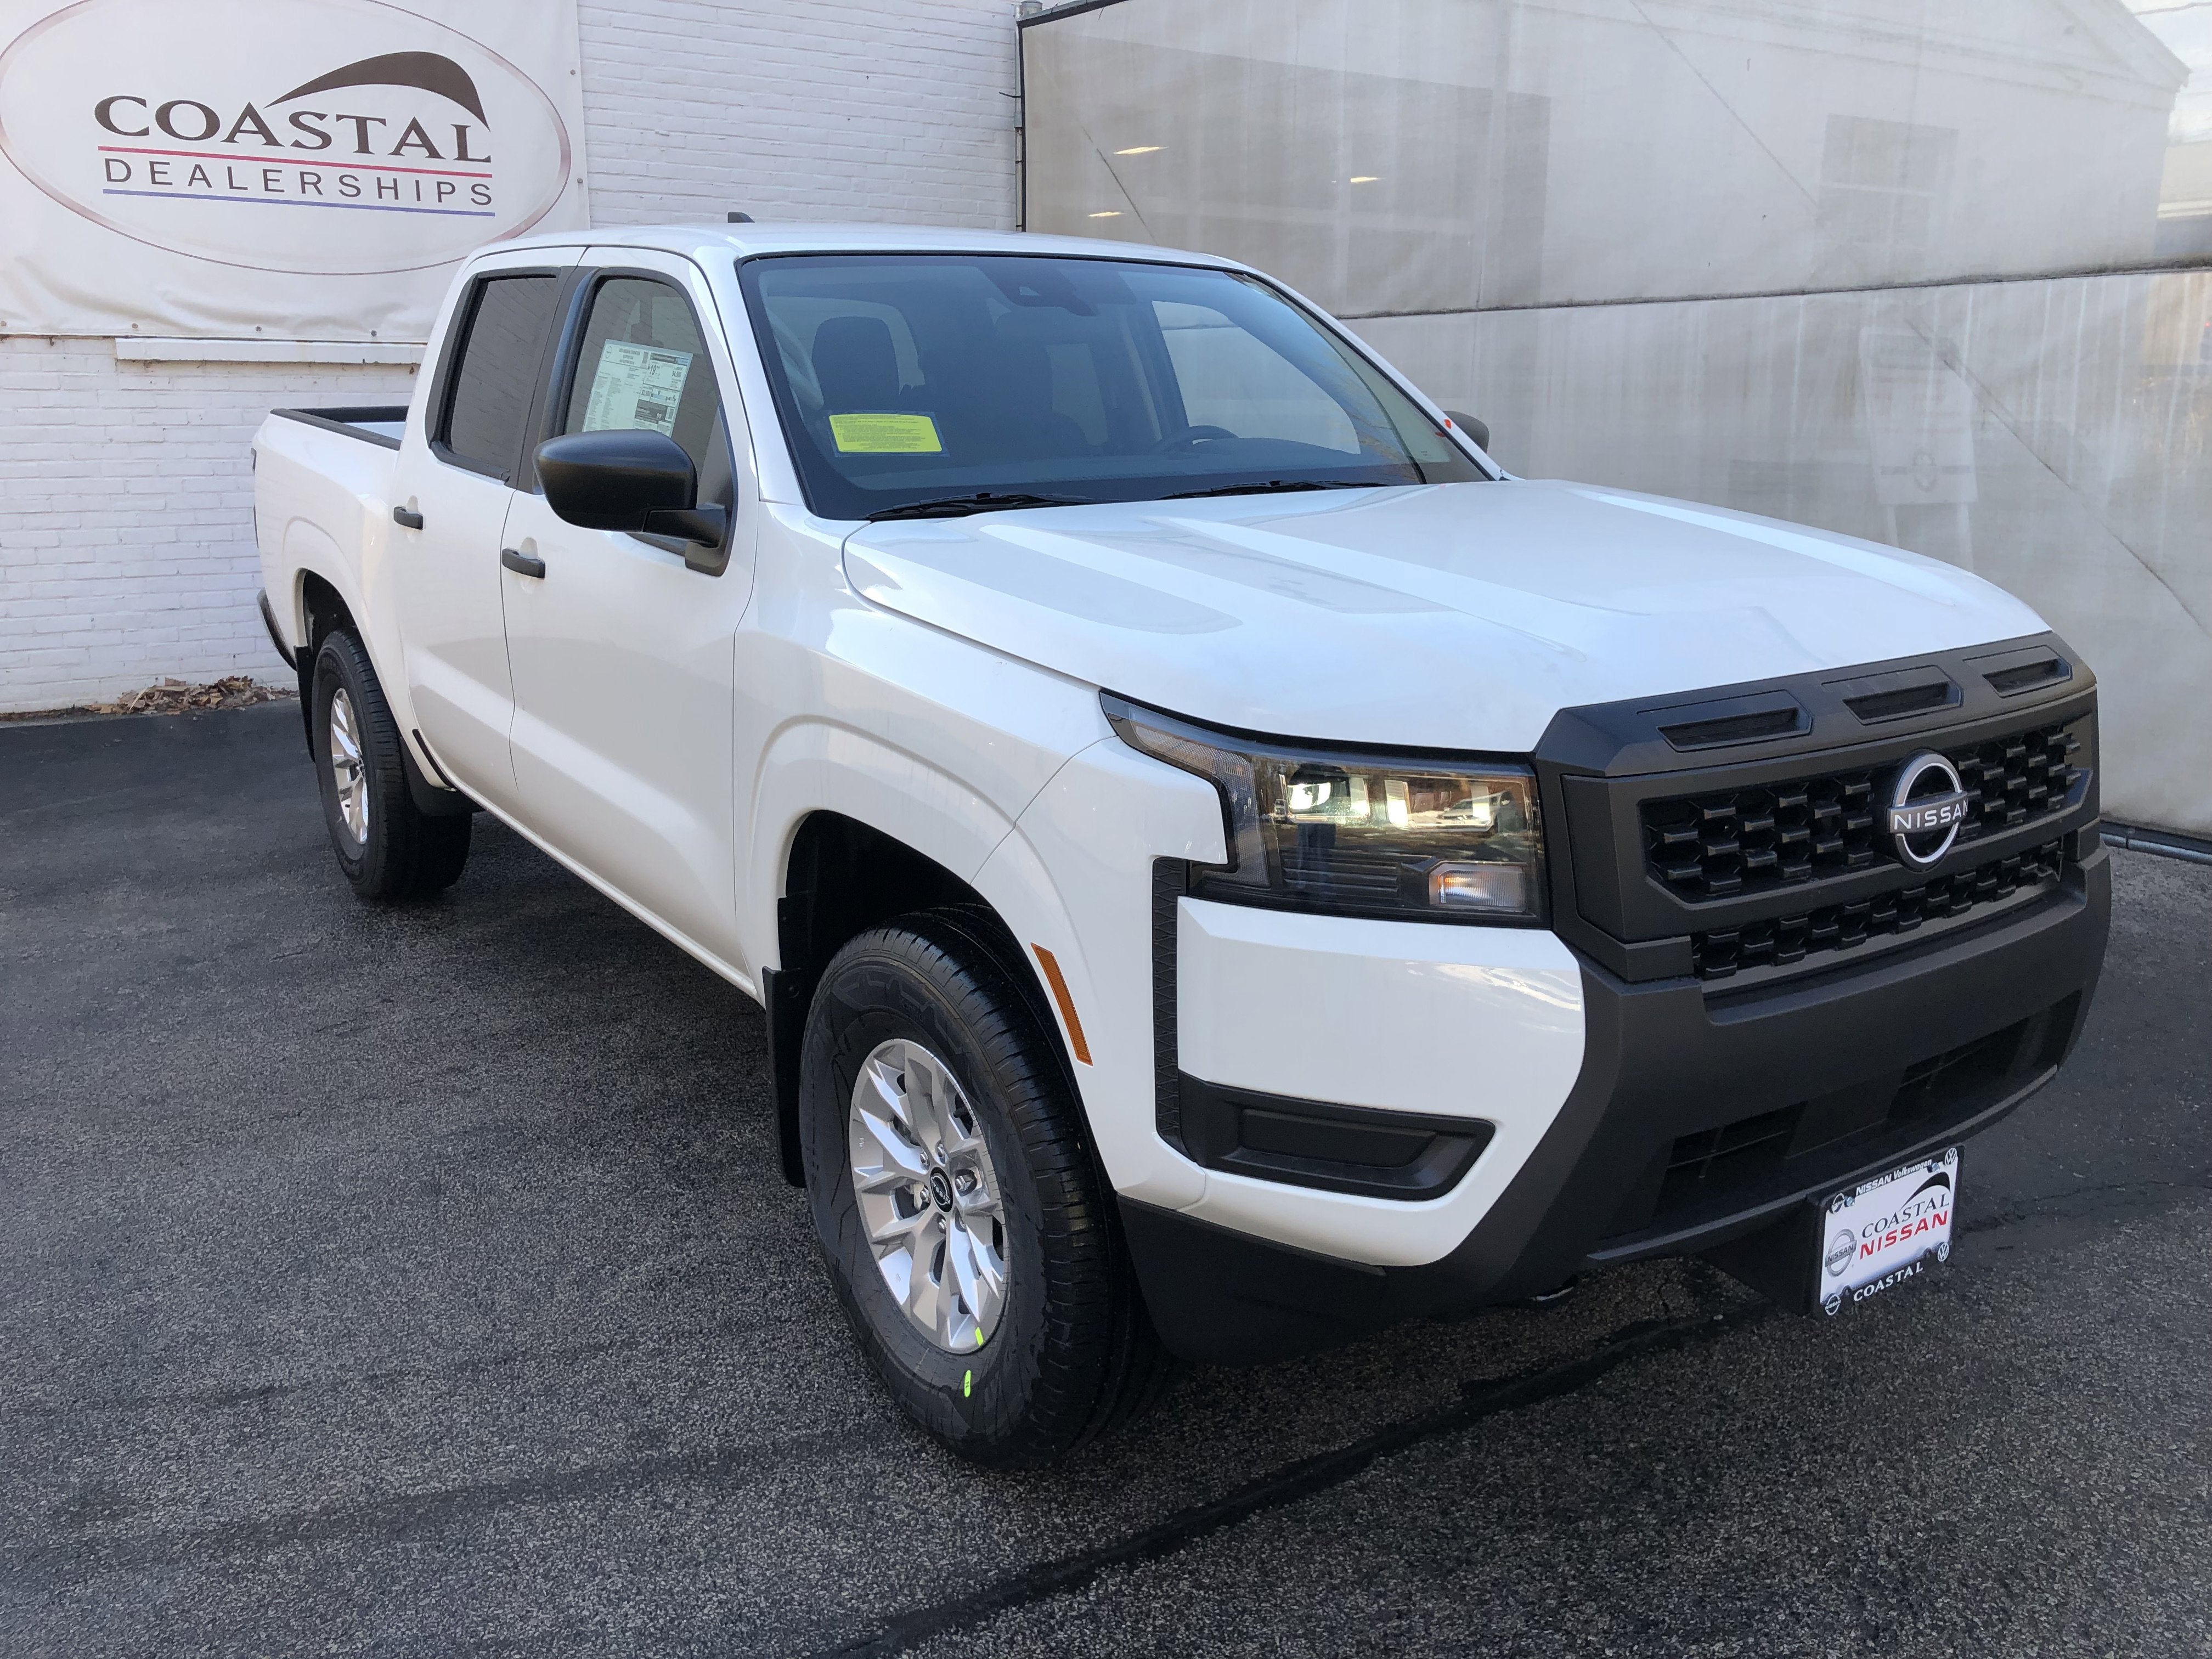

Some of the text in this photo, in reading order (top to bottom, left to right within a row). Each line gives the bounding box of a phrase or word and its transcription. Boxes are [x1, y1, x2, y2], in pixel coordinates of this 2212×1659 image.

[94, 95, 492, 164] COASTAL
[104, 158, 493, 206] DEALERSHIPS
[1893, 799, 1968, 831] NISSAN
[1855, 1159, 1932, 1197] NISSAN Volkswagen
[1860, 1210, 1948, 1260] NISSAN
[1861, 1193, 1950, 1238] COASTAL
[1827, 1244, 1854, 1262] NISSAN
[1853, 1261, 1923, 1302] COASTAL
